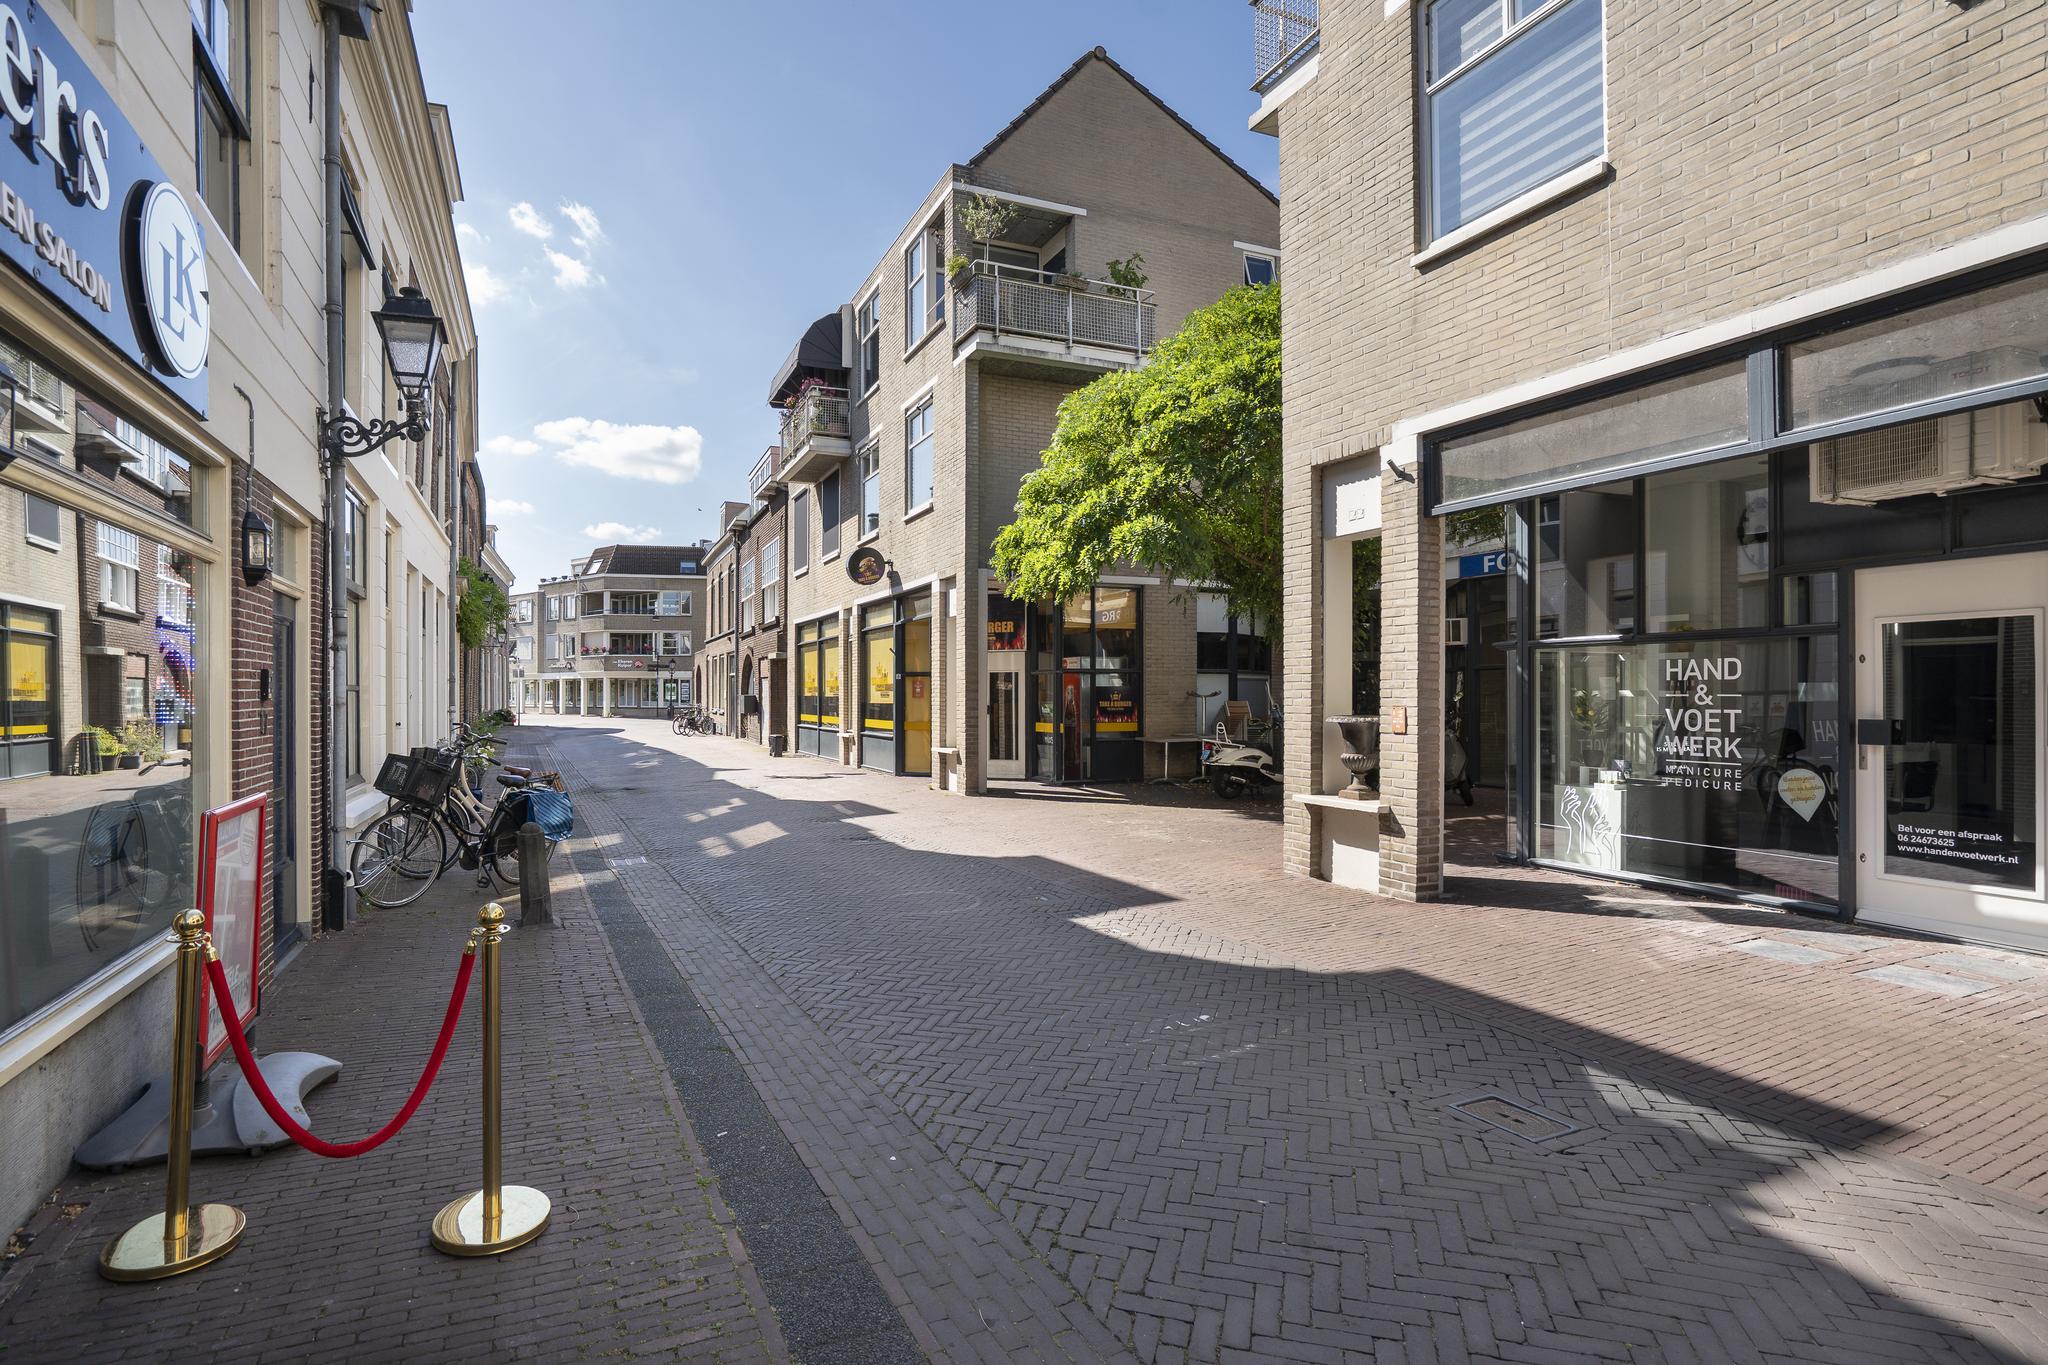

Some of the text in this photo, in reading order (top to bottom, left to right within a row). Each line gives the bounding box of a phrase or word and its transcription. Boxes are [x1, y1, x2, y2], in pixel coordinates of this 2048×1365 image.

[1, 181, 112, 313] EN SALON
[159, 223, 202, 342] LK
[1665, 657, 1742, 681] HAND
[1694, 684, 1714, 706] &
[1665, 708, 1742, 733] VOET
[1665, 735, 1742, 759] WERK
[1665, 765, 1742, 779] MANICURE
[1665, 777, 1742, 791] PEDICURE
[1897, 834, 1955, 847] 06 24673625
[1898, 824, 2003, 842] Bel voor een afspraak
[1897, 844, 2019, 865] www.handenvoetwerk.nl
